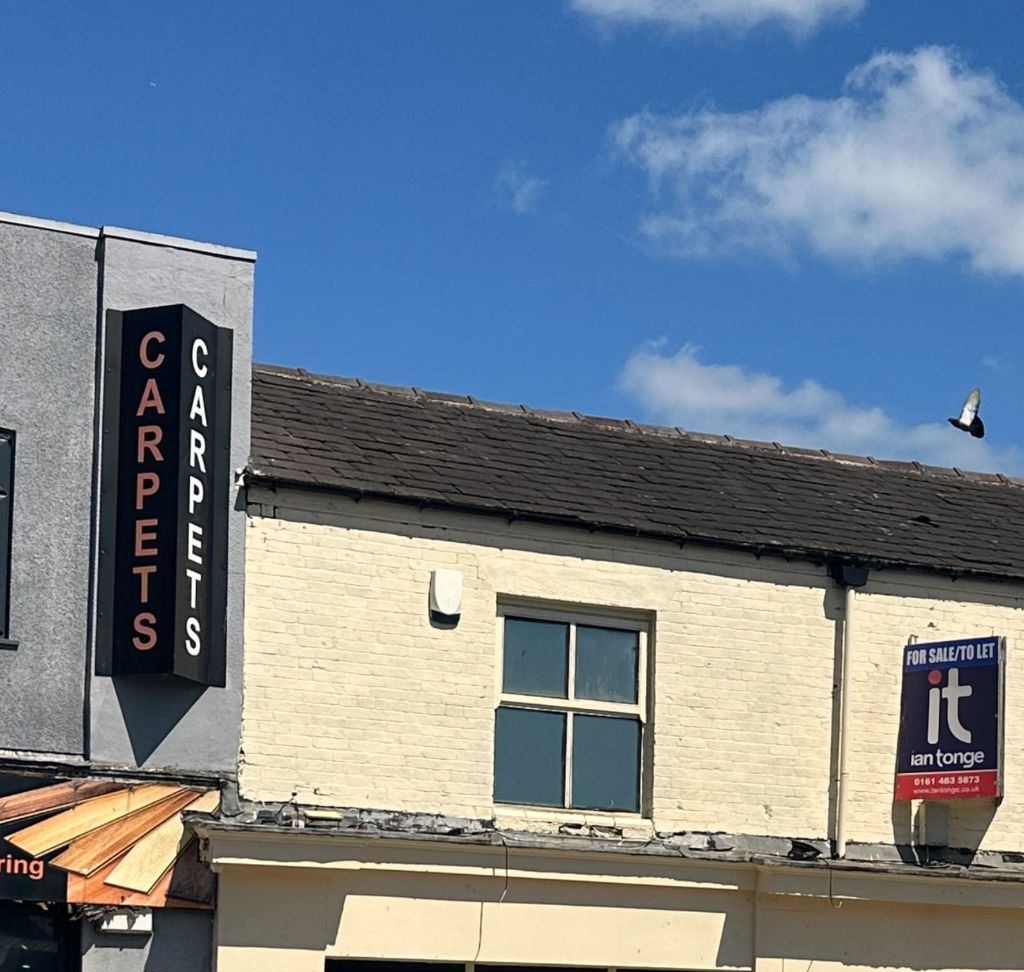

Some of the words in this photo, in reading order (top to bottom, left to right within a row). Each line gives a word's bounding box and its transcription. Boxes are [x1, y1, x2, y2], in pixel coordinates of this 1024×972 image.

[132, 331, 166, 651] CARPETS
[185, 338, 208, 656] CARPETS
[906, 649, 927, 666] FOR
[928, 644, 974, 664] SALE/TO
[976, 642, 995, 660] LET
[927, 667, 972, 744] it
[910, 750, 934, 767] ian
[936, 748, 985, 769] tonge
[914, 777, 935, 786] 0161
